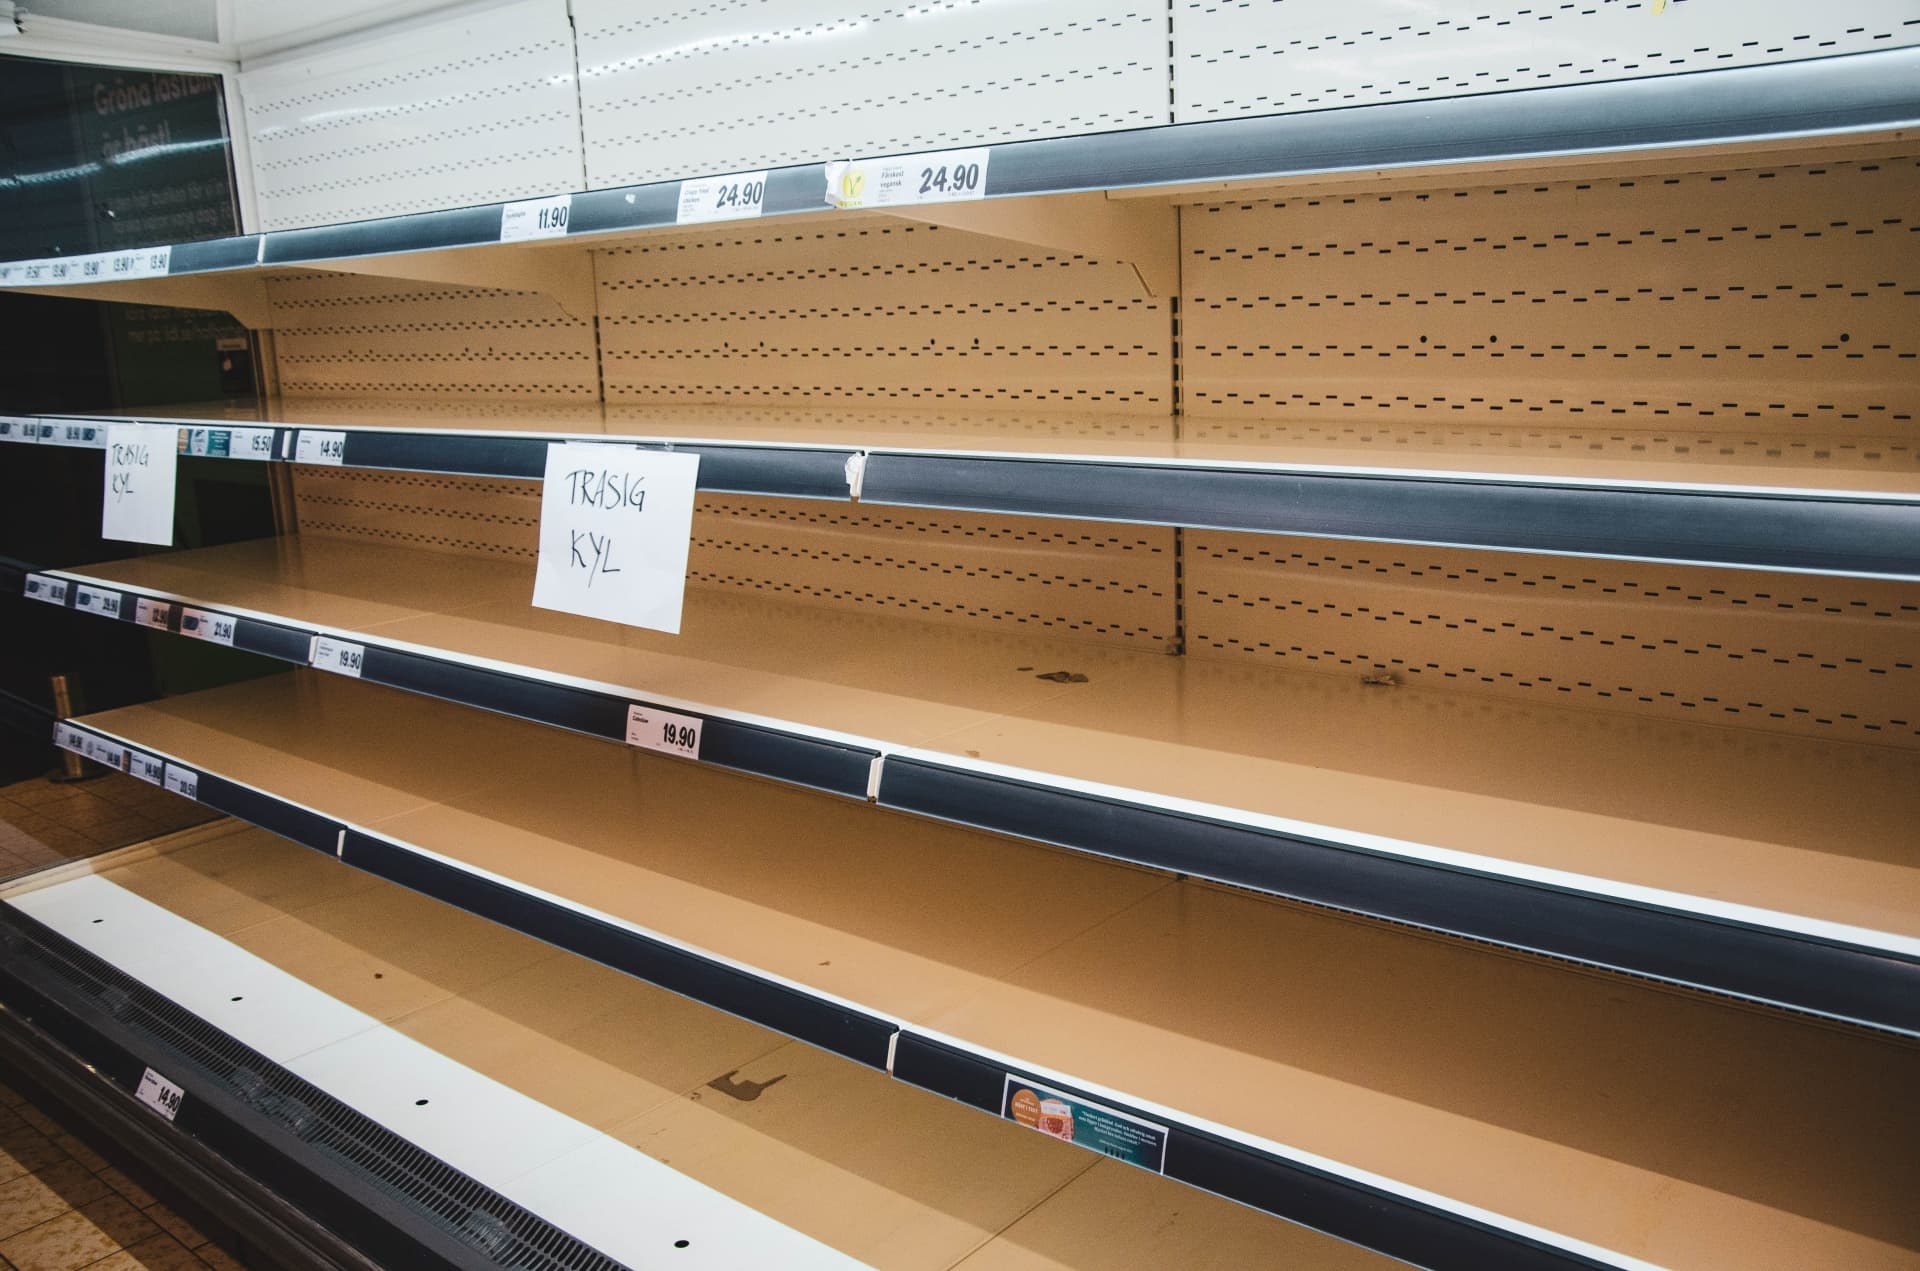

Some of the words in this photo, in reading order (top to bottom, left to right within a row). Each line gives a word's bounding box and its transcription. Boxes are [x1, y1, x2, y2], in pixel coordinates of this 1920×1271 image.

[95, 77, 151, 115] Gröna
[917, 163, 979, 194] 24.90
[716, 181, 763, 208] 24.90
[538, 206, 568, 230] 11.90
[111, 443, 149, 467] TRASIG
[252, 435, 272, 453] 15.50
[320, 440, 343, 459] 14.90
[112, 472, 134, 503] KYL
[564, 468, 646, 513] TRASIG
[571, 529, 621, 588] KYL
[213, 620, 232, 640] 21.90
[339, 649, 362, 671] 19.90
[663, 722, 696, 750] 19.90
[157, 1085, 181, 1113] 14.90
